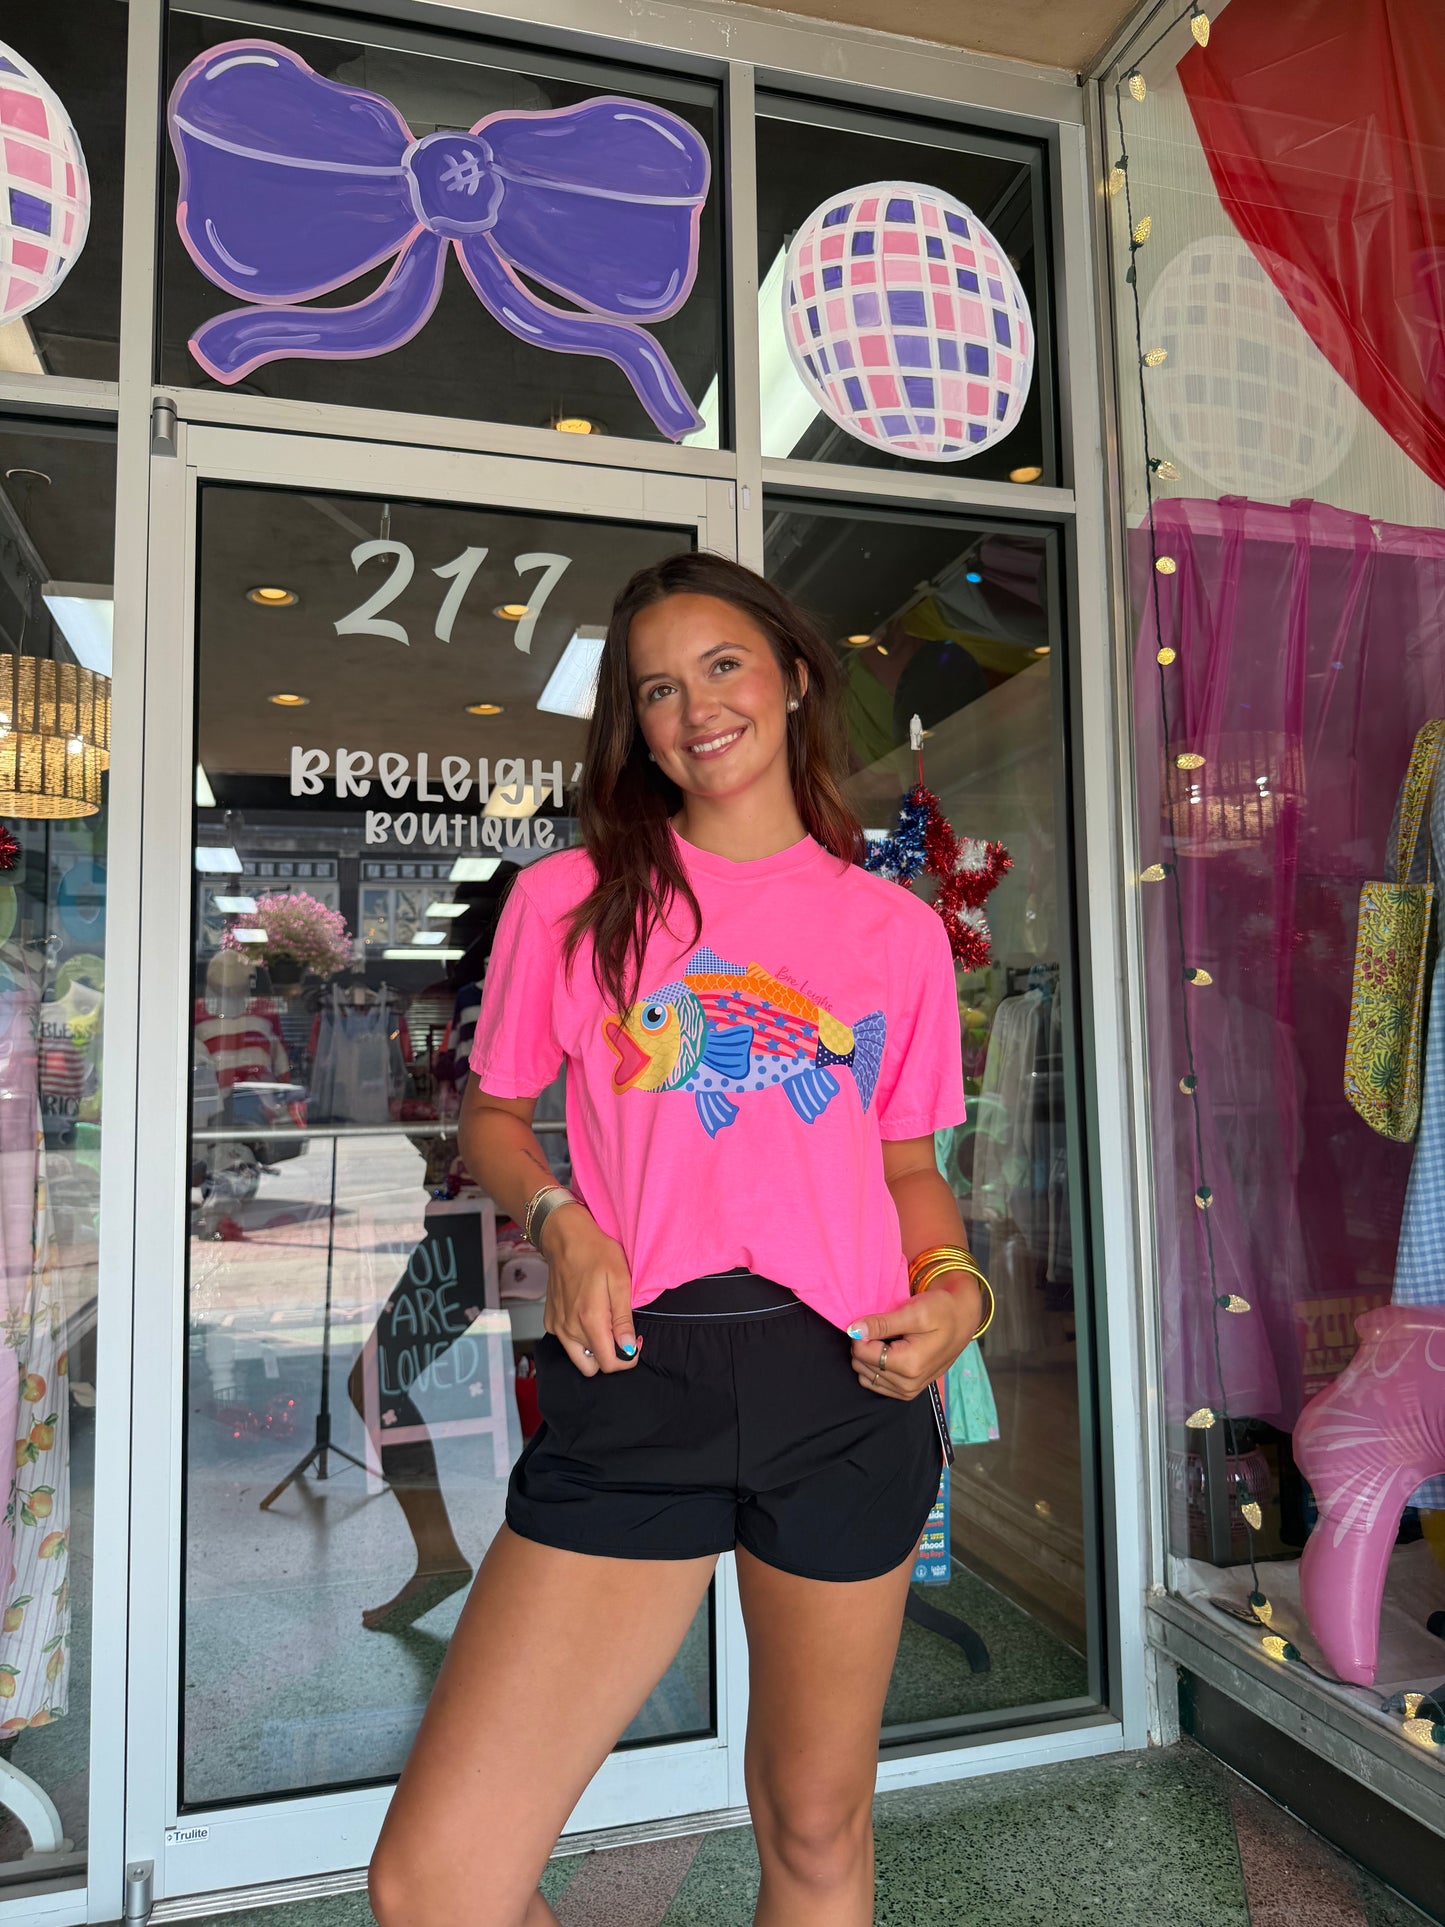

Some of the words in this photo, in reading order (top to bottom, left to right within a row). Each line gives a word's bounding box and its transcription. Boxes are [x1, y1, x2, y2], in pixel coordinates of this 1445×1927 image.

[334, 539, 573, 655] 217
[290, 746, 583, 808] BRELEIGH'
[390, 1280, 468, 1336] ARE
[379, 1337, 479, 1395] LOVED
[174, 1829, 208, 1840] Trulite
